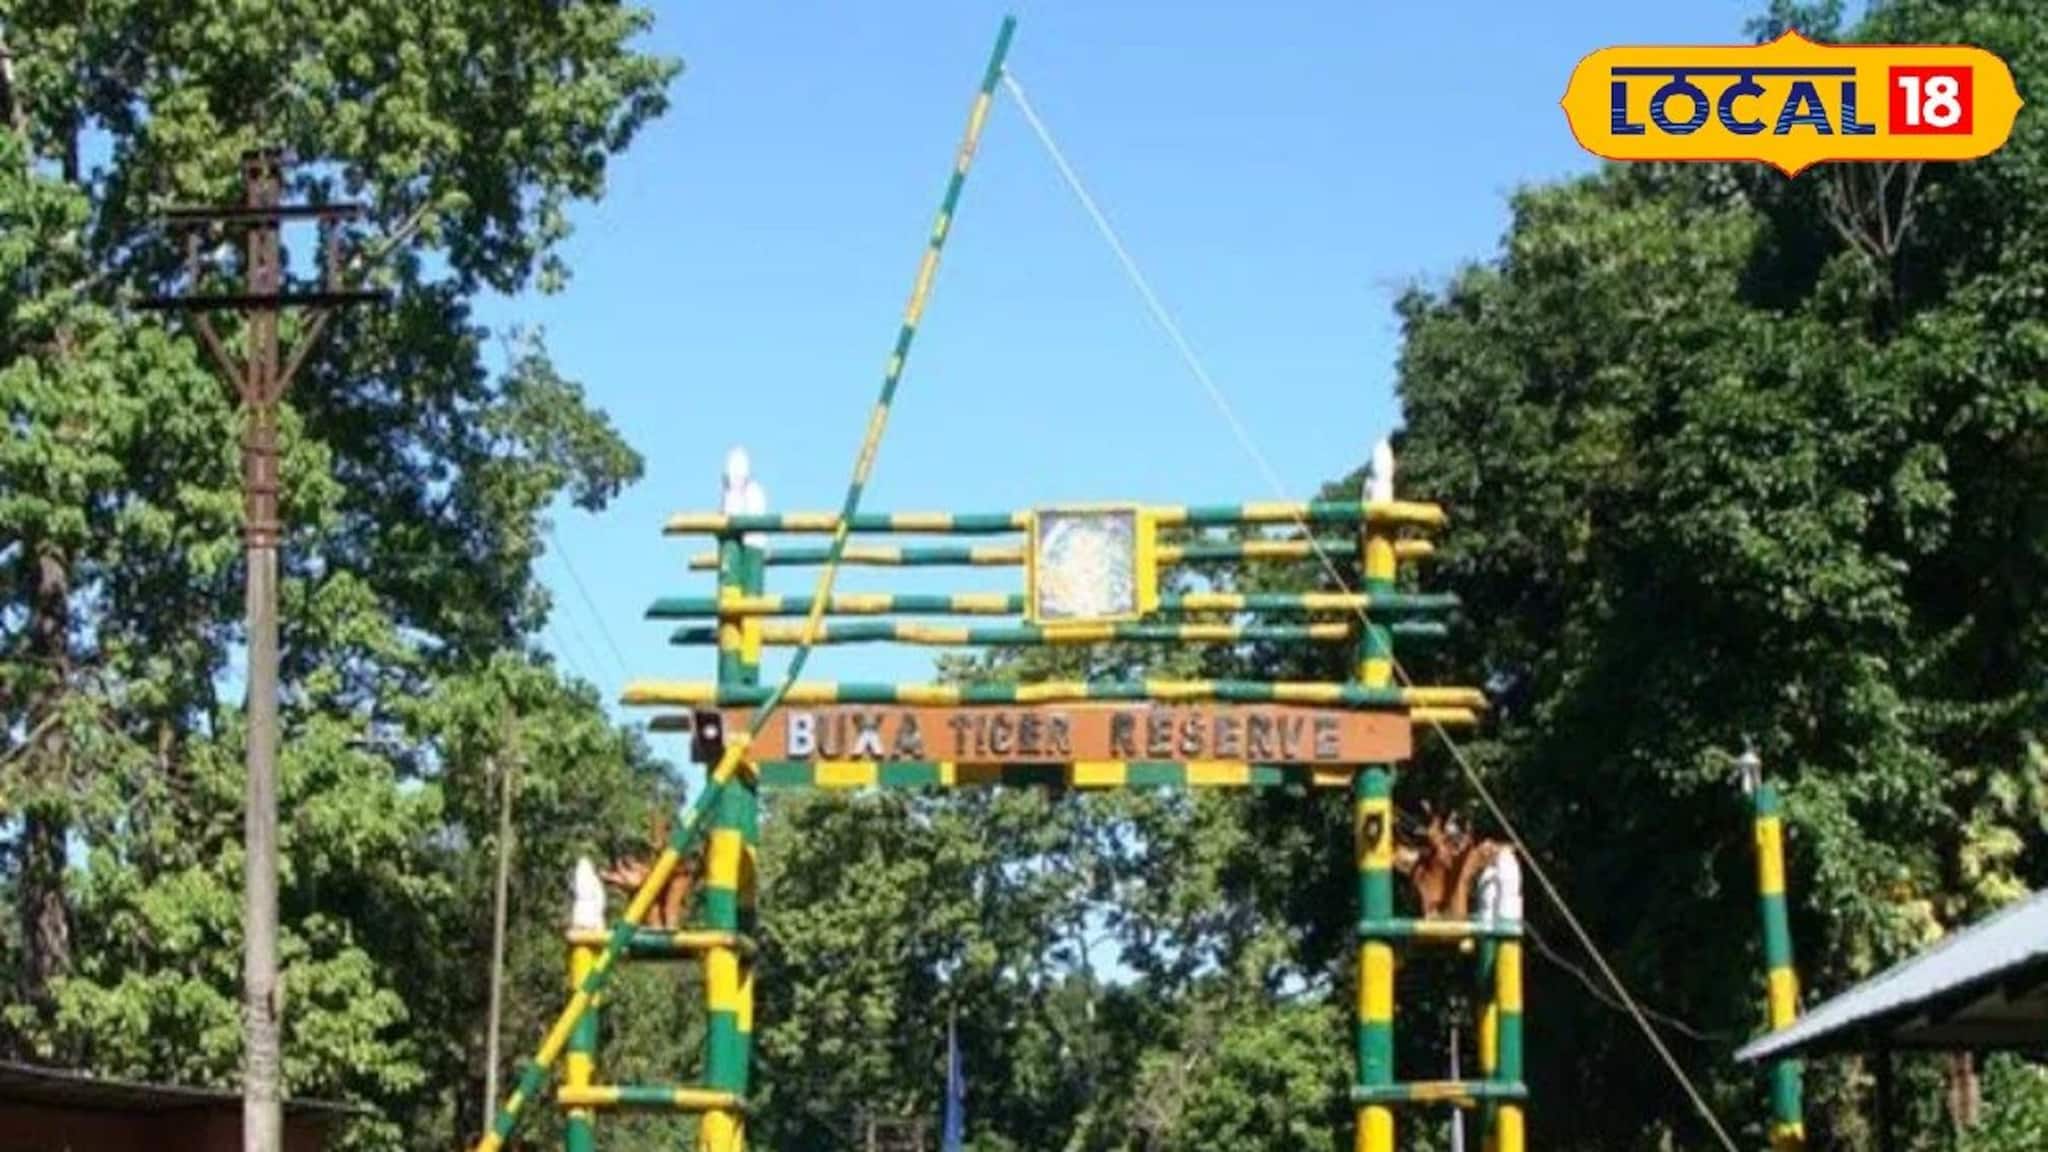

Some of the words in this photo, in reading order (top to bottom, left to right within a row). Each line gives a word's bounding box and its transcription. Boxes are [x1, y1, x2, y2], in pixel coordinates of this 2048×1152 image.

[787, 711, 923, 761] BUXA
[949, 711, 1072, 757] TIGER
[1109, 704, 1341, 761] RESERVE
